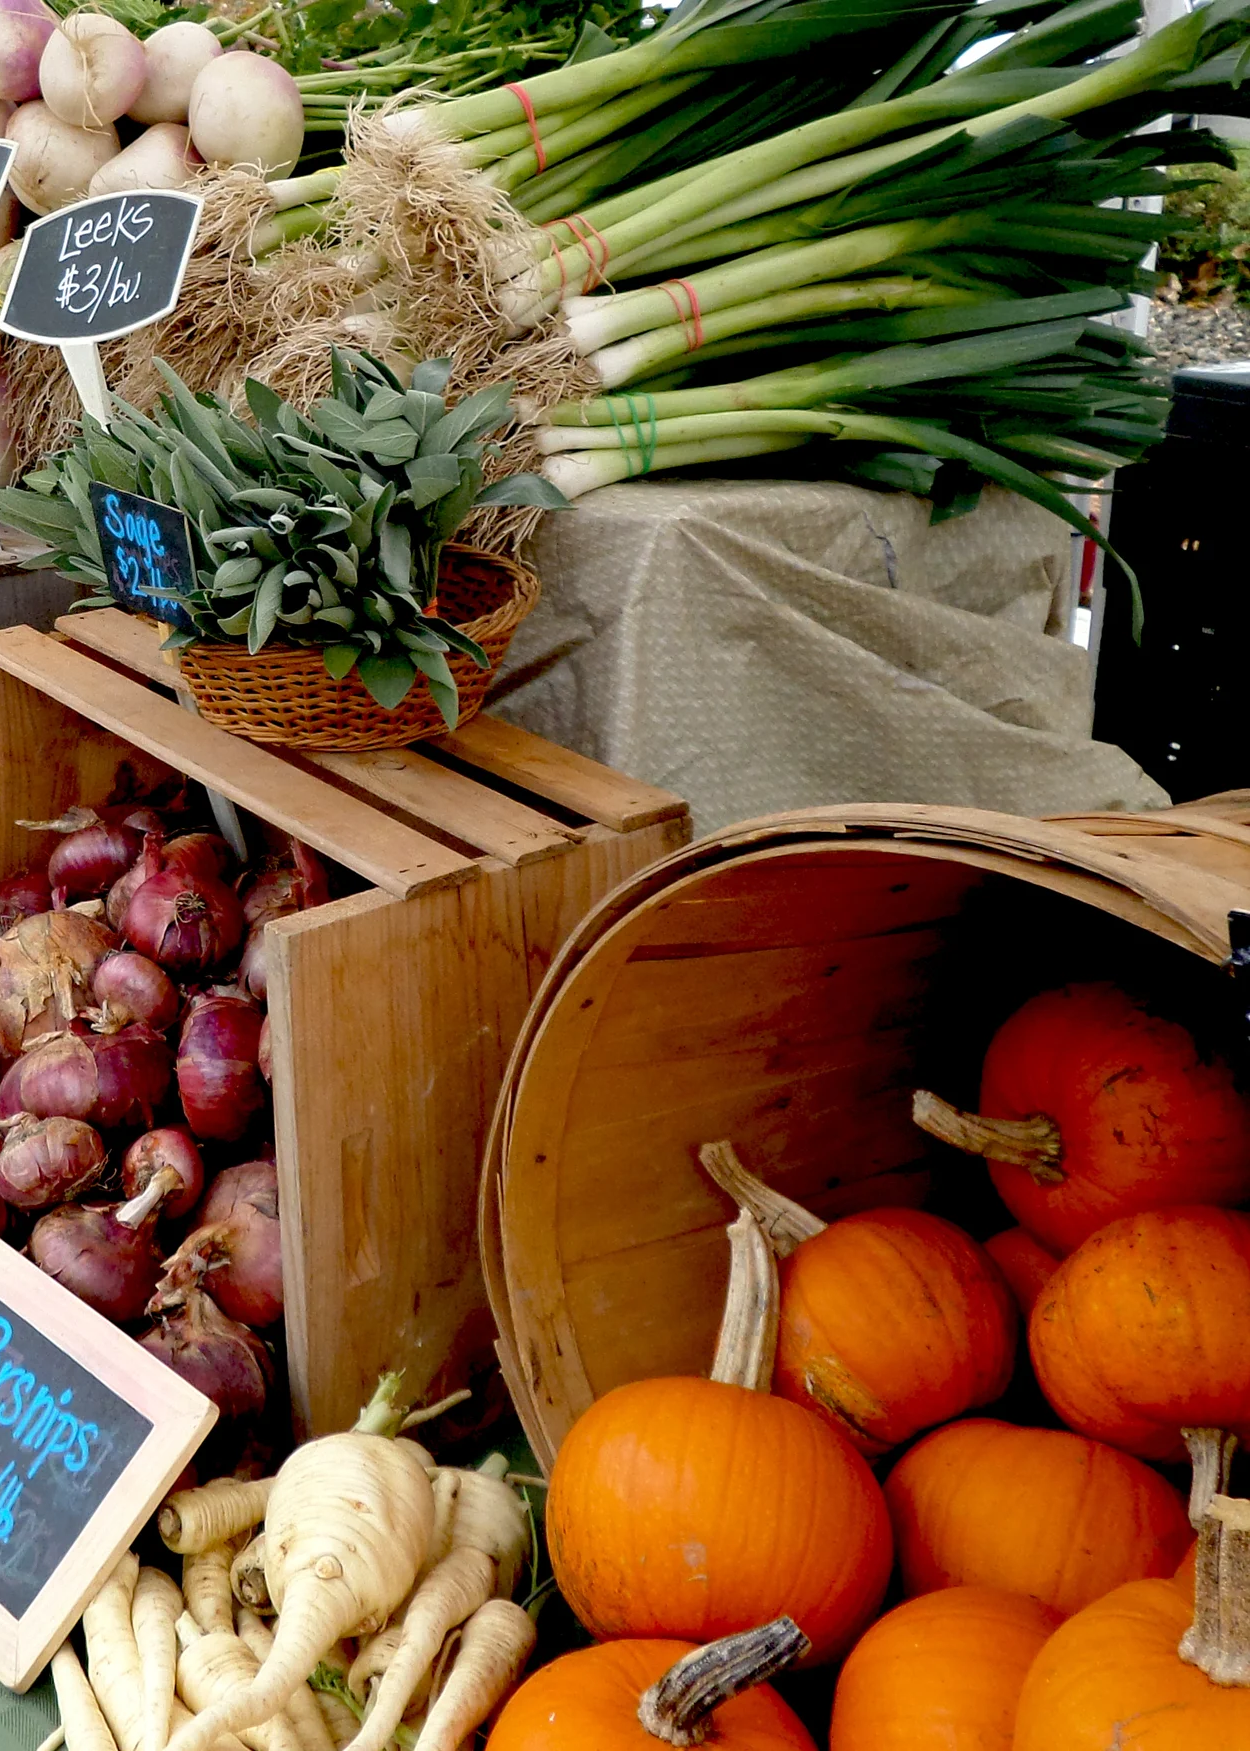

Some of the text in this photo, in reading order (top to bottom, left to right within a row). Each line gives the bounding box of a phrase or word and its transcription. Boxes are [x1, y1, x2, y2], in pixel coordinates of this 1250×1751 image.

[59, 198, 154, 262] Leeks
[55, 257, 141, 323] $3/bu.
[105, 494, 165, 569] Sage
